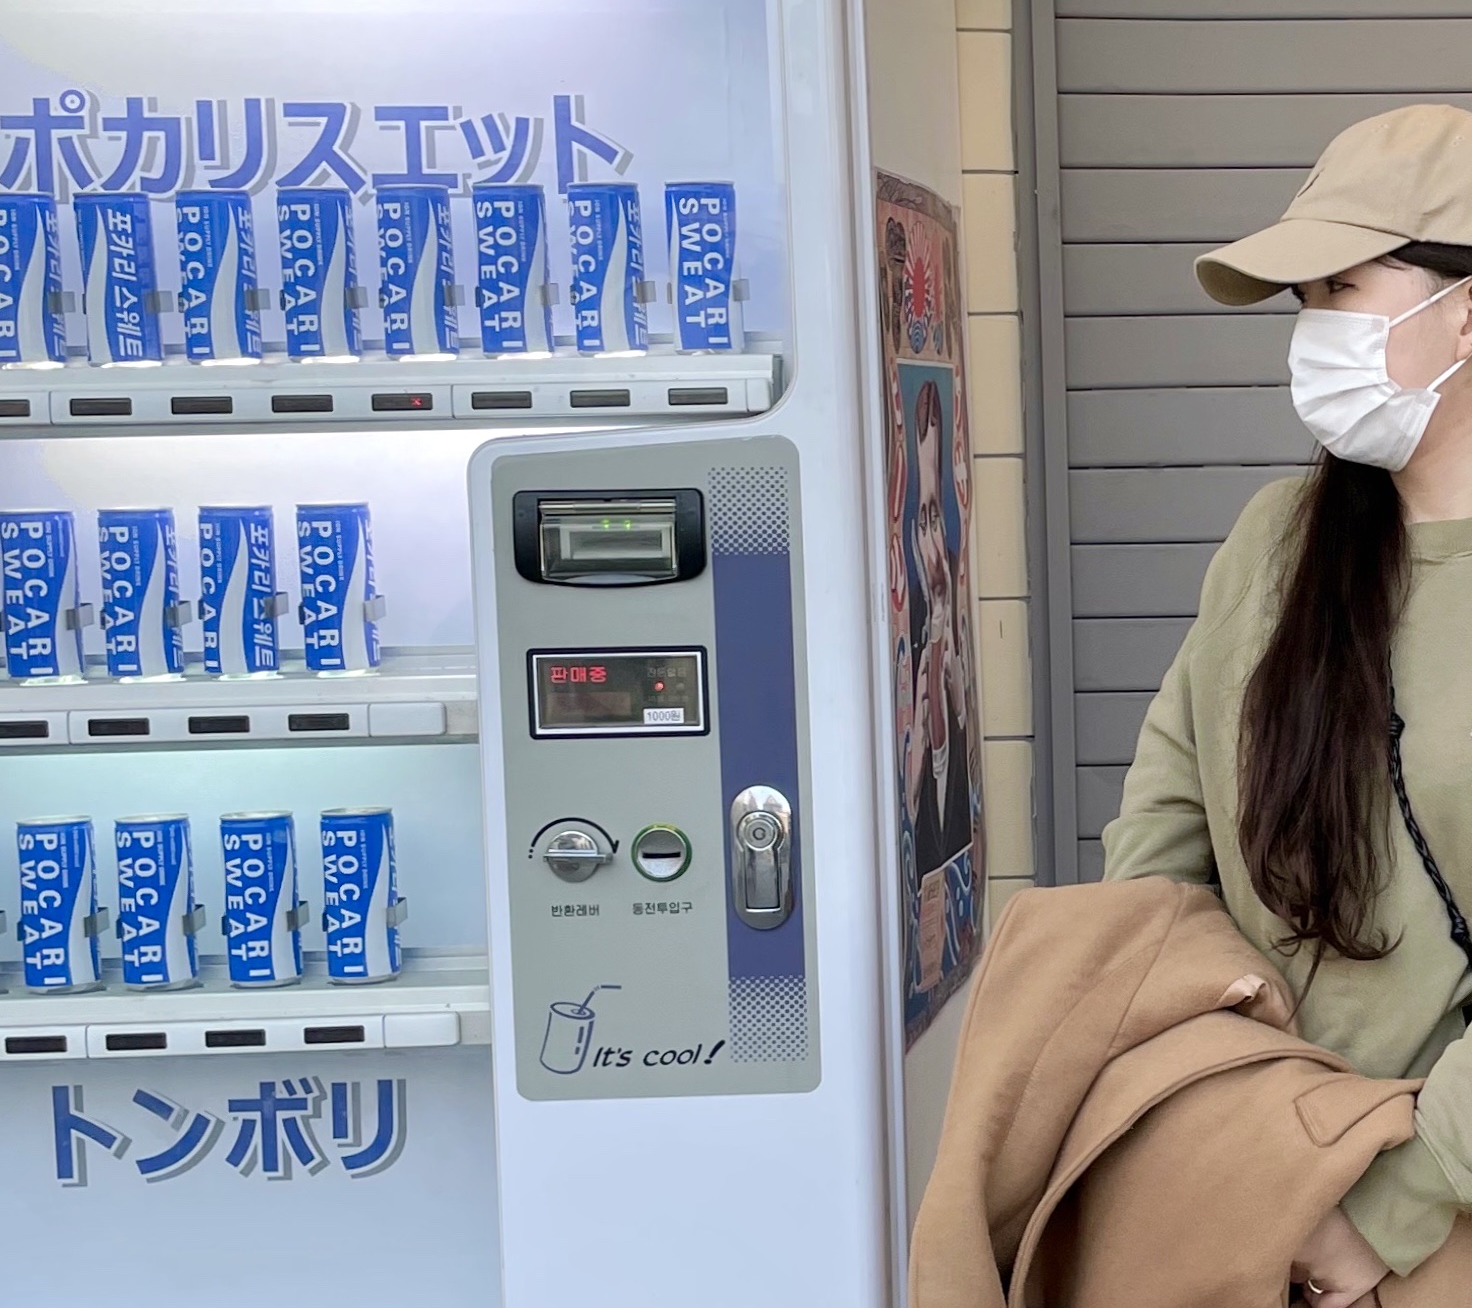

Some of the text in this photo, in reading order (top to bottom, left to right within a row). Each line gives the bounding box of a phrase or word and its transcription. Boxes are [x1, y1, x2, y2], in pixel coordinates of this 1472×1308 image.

[0, 89, 634, 201] ポカリスエット
[107, 208, 143, 358] 포카리 스웨트
[183, 206, 210, 354] POCARI
[278, 205, 298, 336] SWEAT
[290, 203, 320, 352] POCARI
[384, 202, 410, 350] POCARI
[476, 201, 499, 332] SWEAT
[493, 201, 523, 348] POCARI
[575, 200, 600, 347] POCARI
[679, 197, 705, 329] SWEAT
[700, 198, 729, 345] POCARI
[1, 522, 28, 661] SWEAT
[20, 521, 53, 675] POCARI
[109, 526, 138, 672] POCARI
[200, 523, 219, 669] POCARI
[250, 523, 271, 594] 포카리
[298, 521, 319, 650] SWEAT
[312, 520, 342, 666] POCARI
[550, 666, 607, 684] 판매중
[646, 710, 681, 722] 1000원
[19, 834, 42, 970] SWEAT
[35, 833, 67, 985] POCARI
[117, 831, 140, 968] SWEAT
[132, 831, 164, 982] POCARI
[224, 834, 247, 962] SWEAT
[240, 833, 271, 977] POCARI
[322, 830, 342, 958] SWEAT
[336, 830, 364, 973] POCARI
[551, 901, 693, 918] 반환레버 동전투입구
[592, 1039, 726, 1068] It's cool!
[52, 1076, 407, 1187] トンボリ
